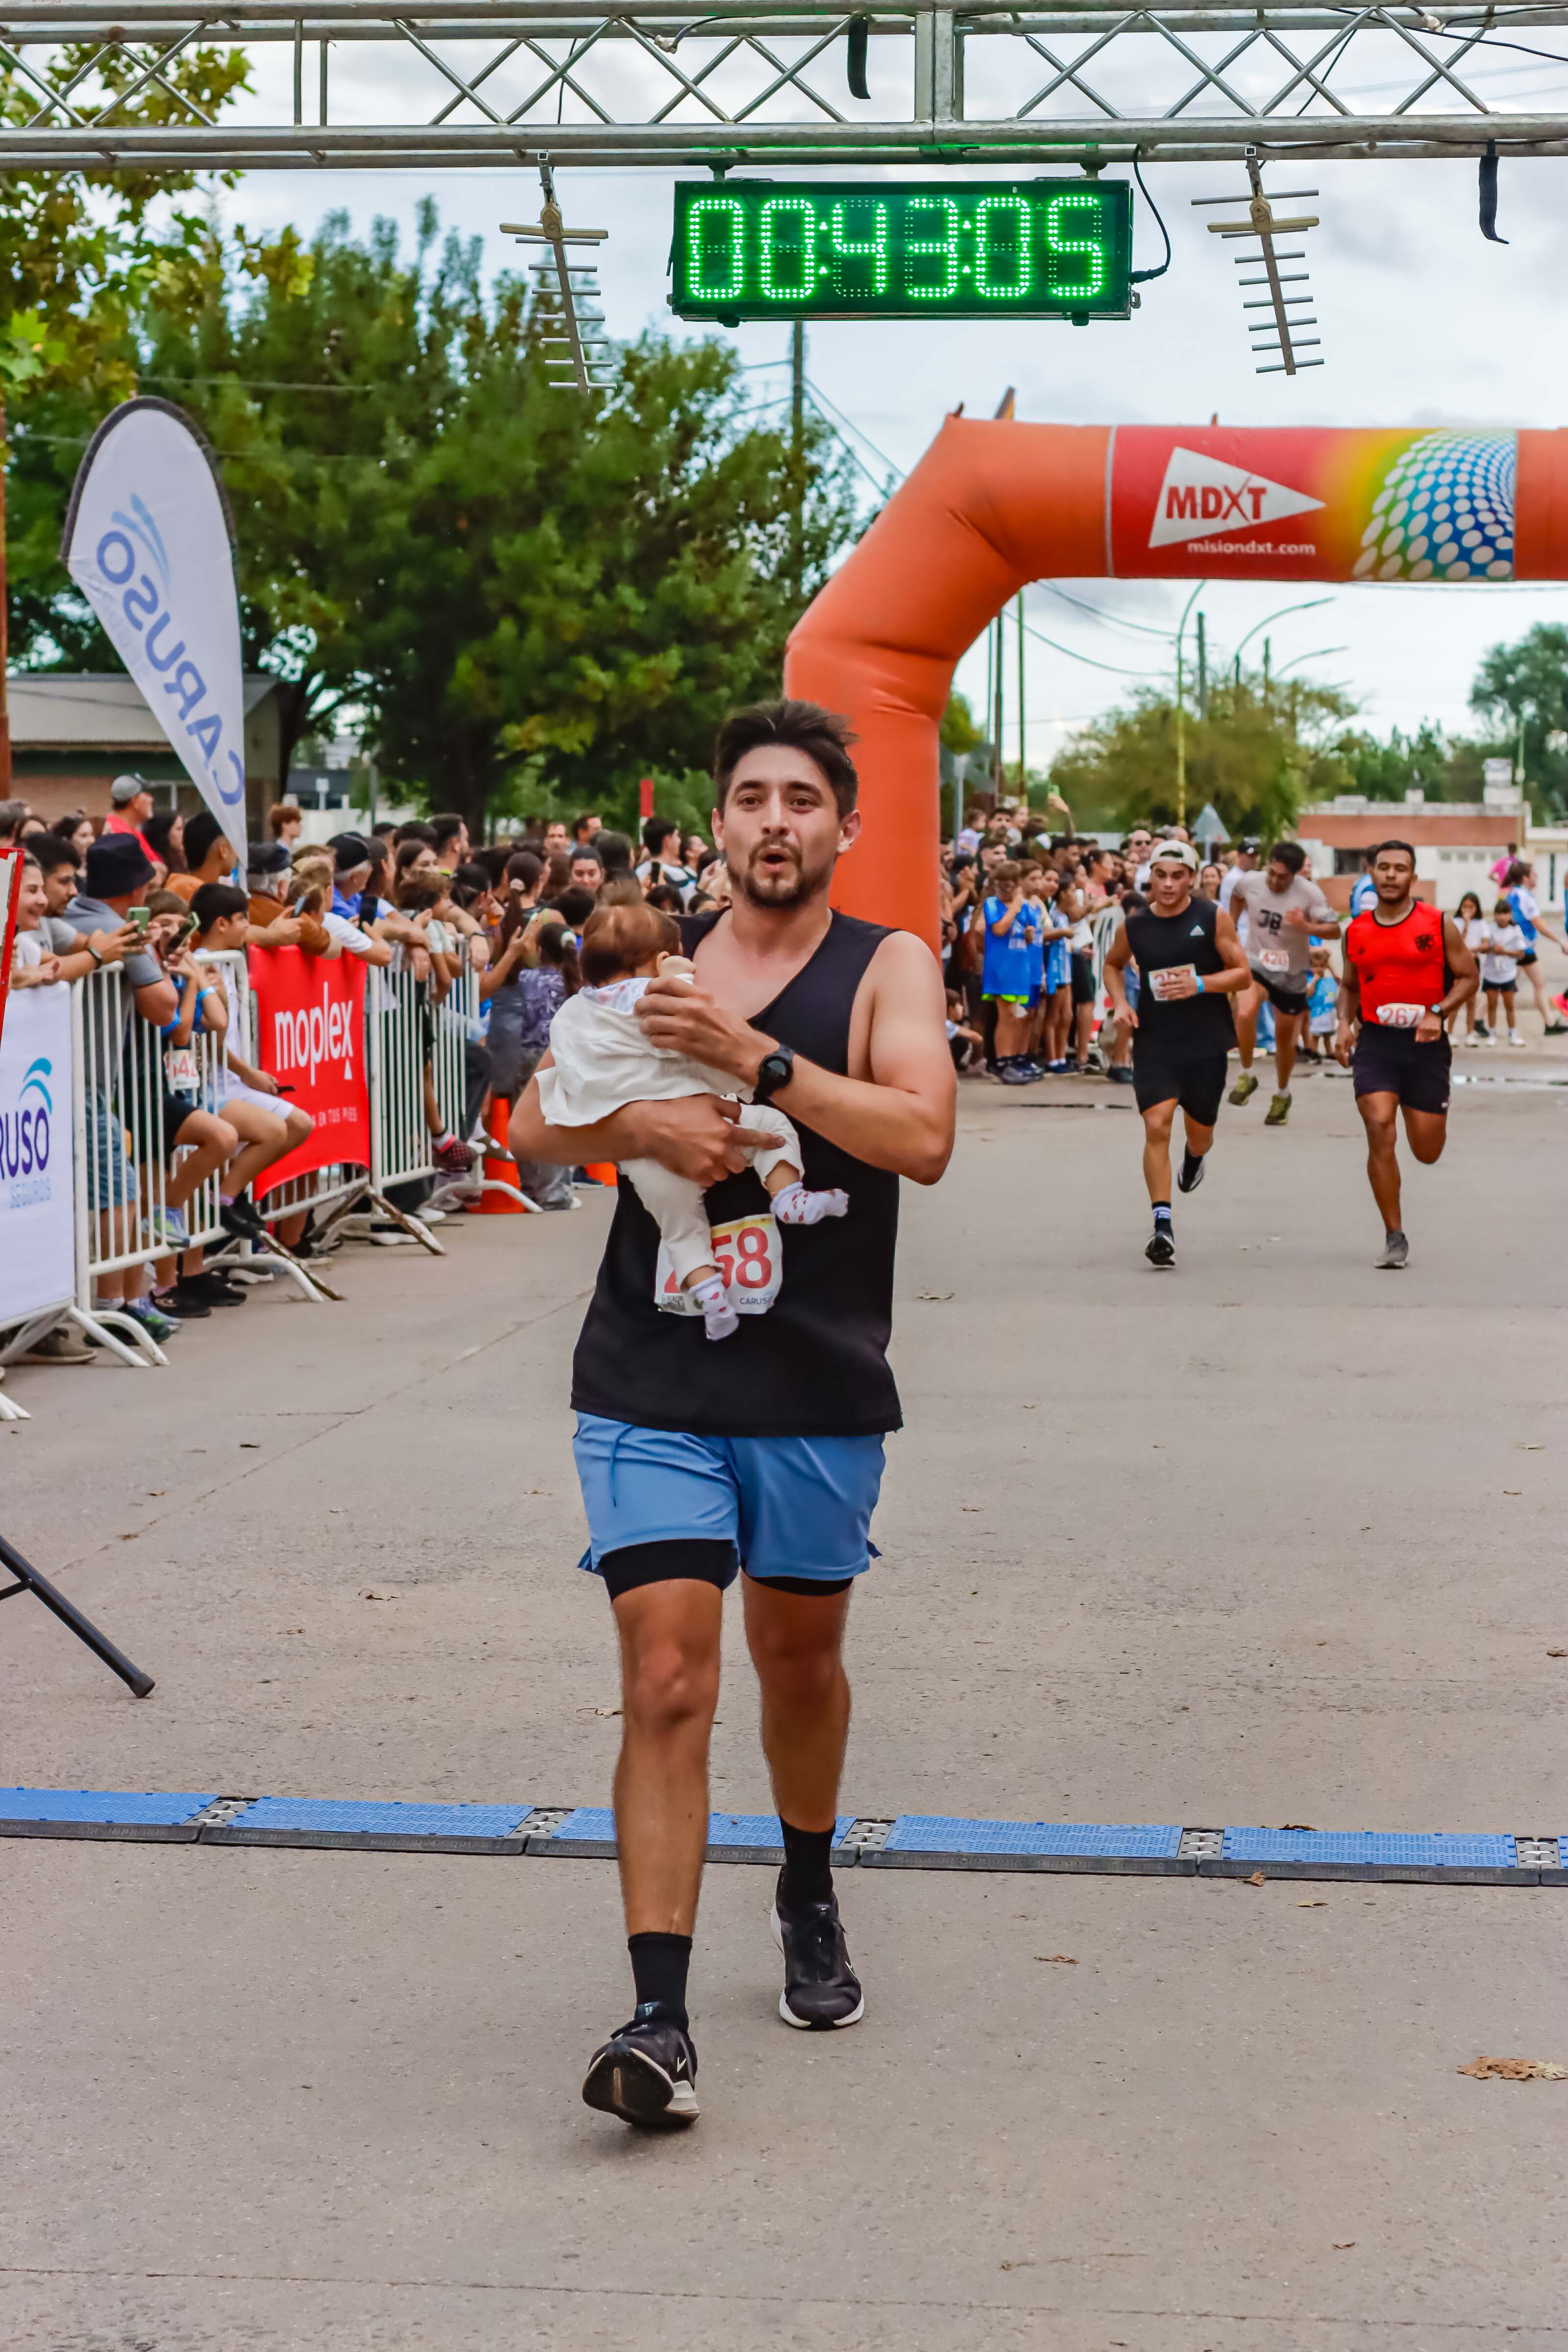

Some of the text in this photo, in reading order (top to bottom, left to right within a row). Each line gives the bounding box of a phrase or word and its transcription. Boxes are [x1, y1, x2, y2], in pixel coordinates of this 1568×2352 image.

[689, 196, 1102, 298] 00:43:05
[1166, 476, 1267, 525] MDXT
[1187, 539, 1316, 556] misiondxt.com
[275, 980, 353, 1086] moplex
[1380, 1007, 1421, 1026] 267
[664, 1226, 772, 1293] 58
